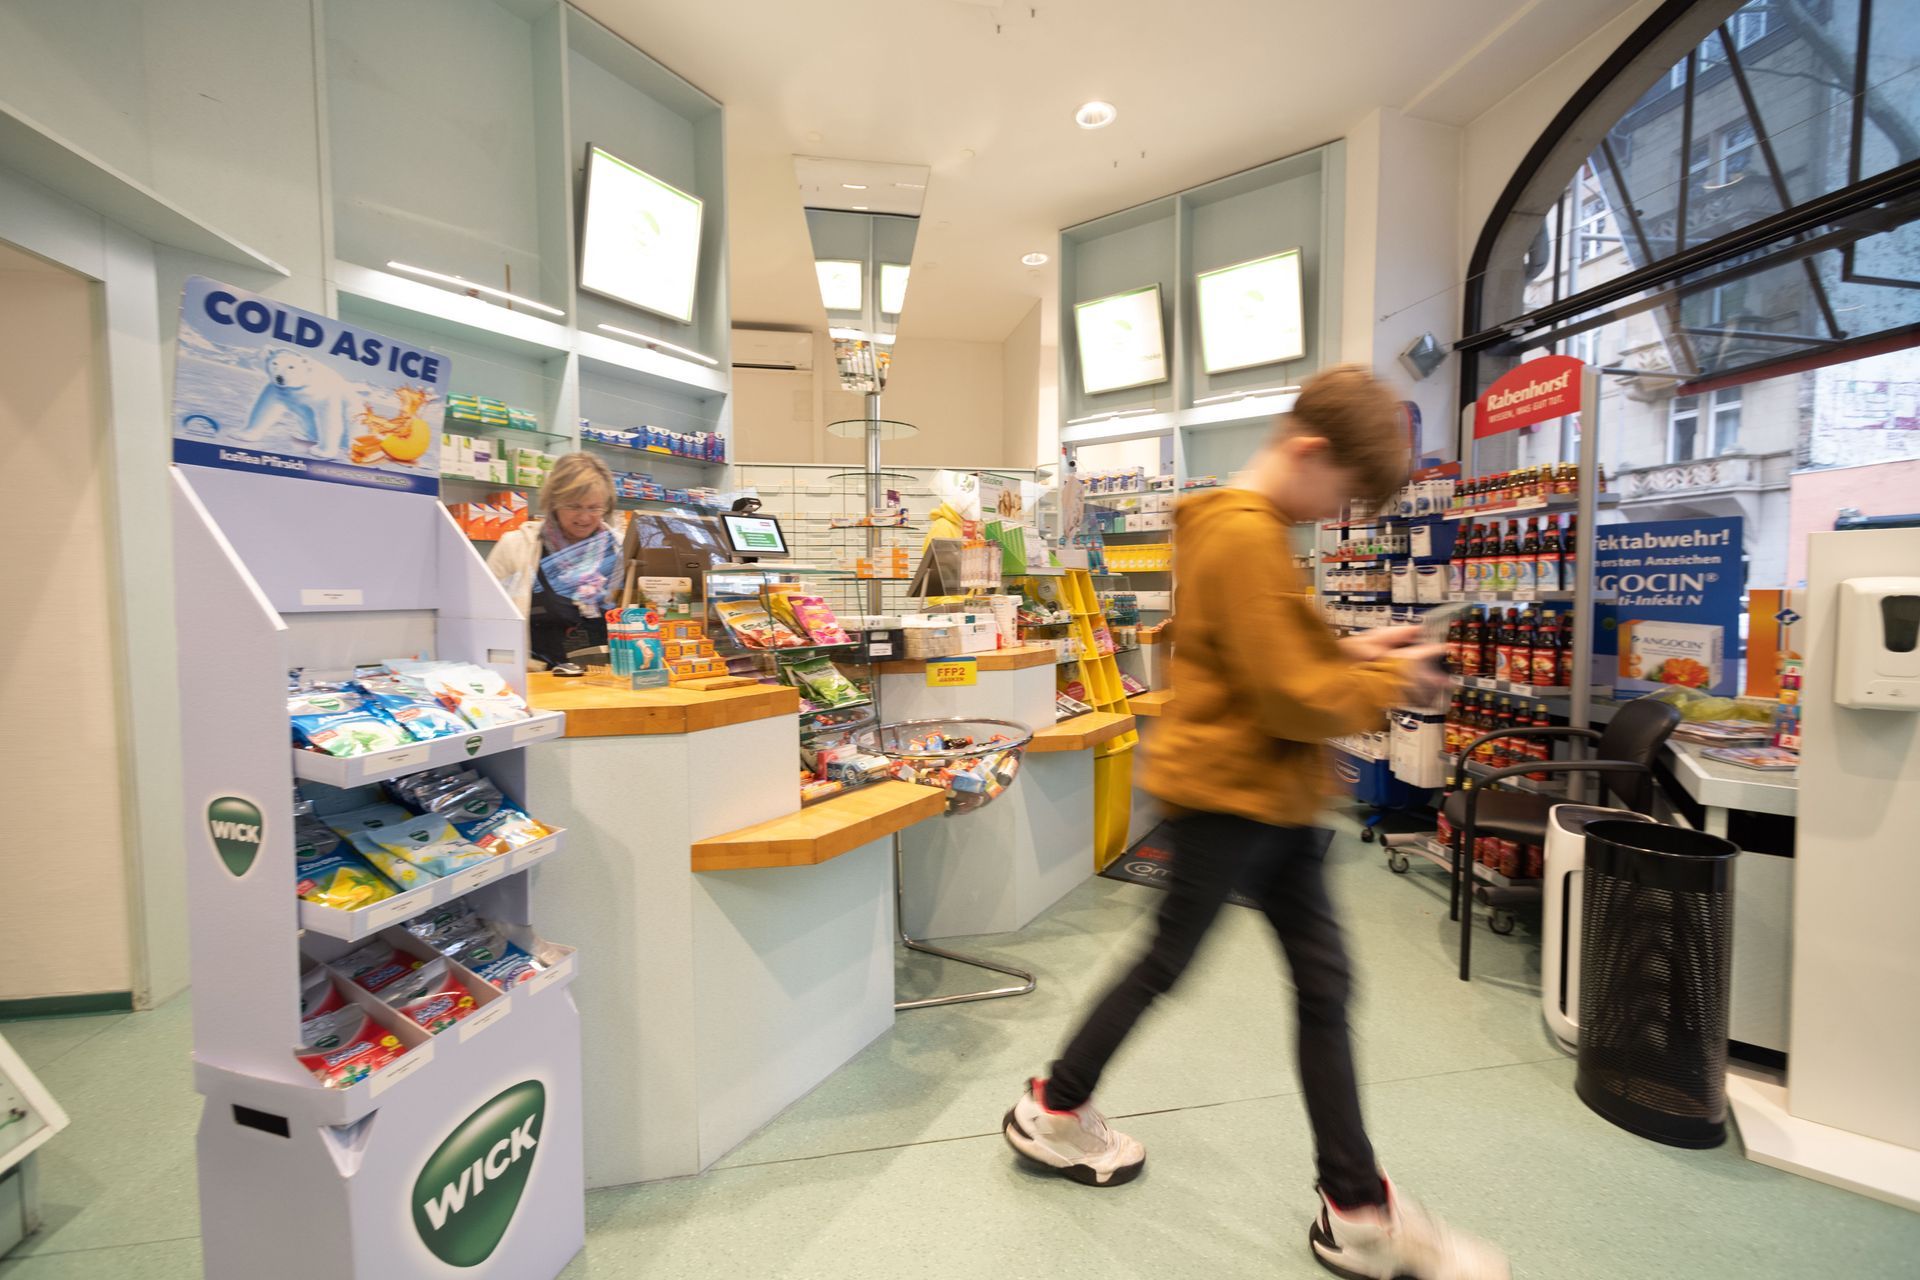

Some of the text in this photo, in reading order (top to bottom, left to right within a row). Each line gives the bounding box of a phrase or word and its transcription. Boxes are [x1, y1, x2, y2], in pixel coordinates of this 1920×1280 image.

[204, 290, 440, 383] COLD AS ICE
[1487, 370, 1570, 412] Rabenhorst
[1601, 554, 1722, 567] ersten Anzeichen
[1617, 594, 1683, 606] ti-Infekt
[936, 666, 966, 677] FFP2
[210, 819, 261, 844] WICK
[423, 1113, 538, 1231] WICK
